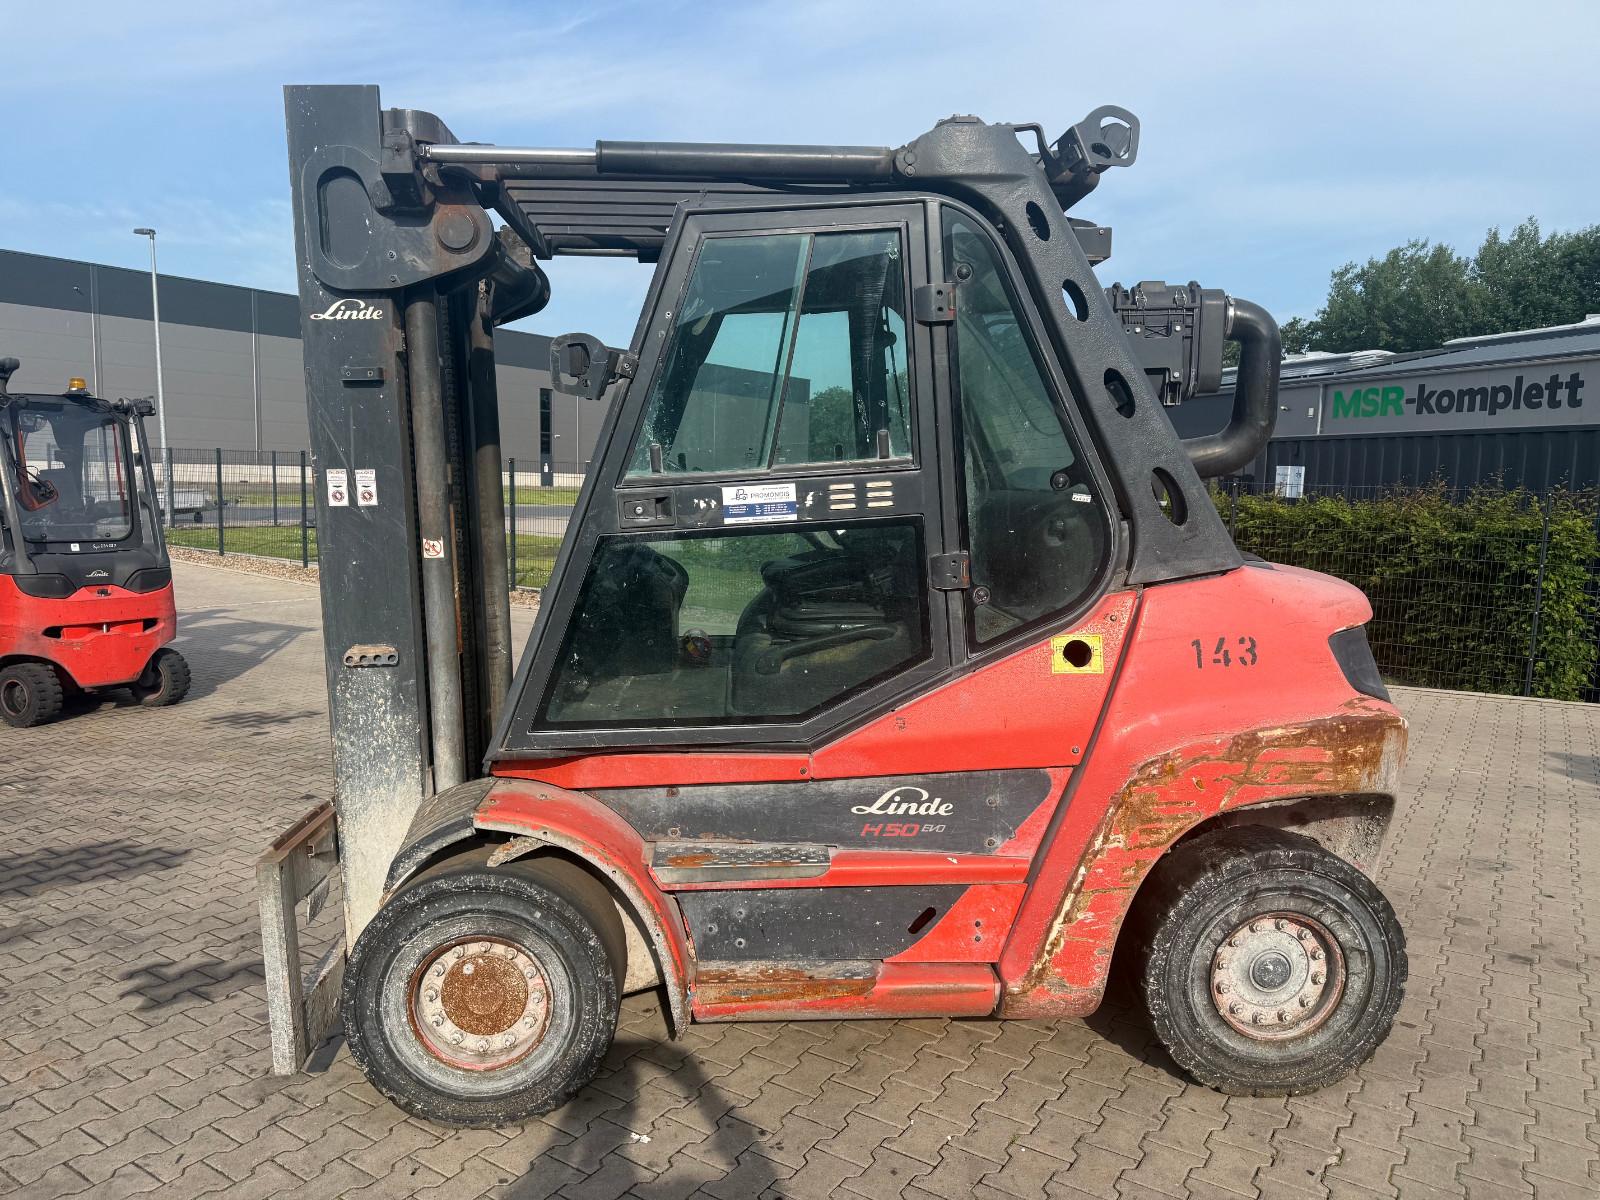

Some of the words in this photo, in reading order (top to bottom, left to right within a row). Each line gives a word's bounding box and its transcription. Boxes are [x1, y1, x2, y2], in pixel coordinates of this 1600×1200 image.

[310, 299, 383, 320] Linde
[1332, 372, 1585, 419] MSR-komplett
[86, 569, 110, 578] Linde
[1191, 636, 1258, 669] 143
[851, 786, 954, 816] Linde
[921, 824, 947, 833] EVO
